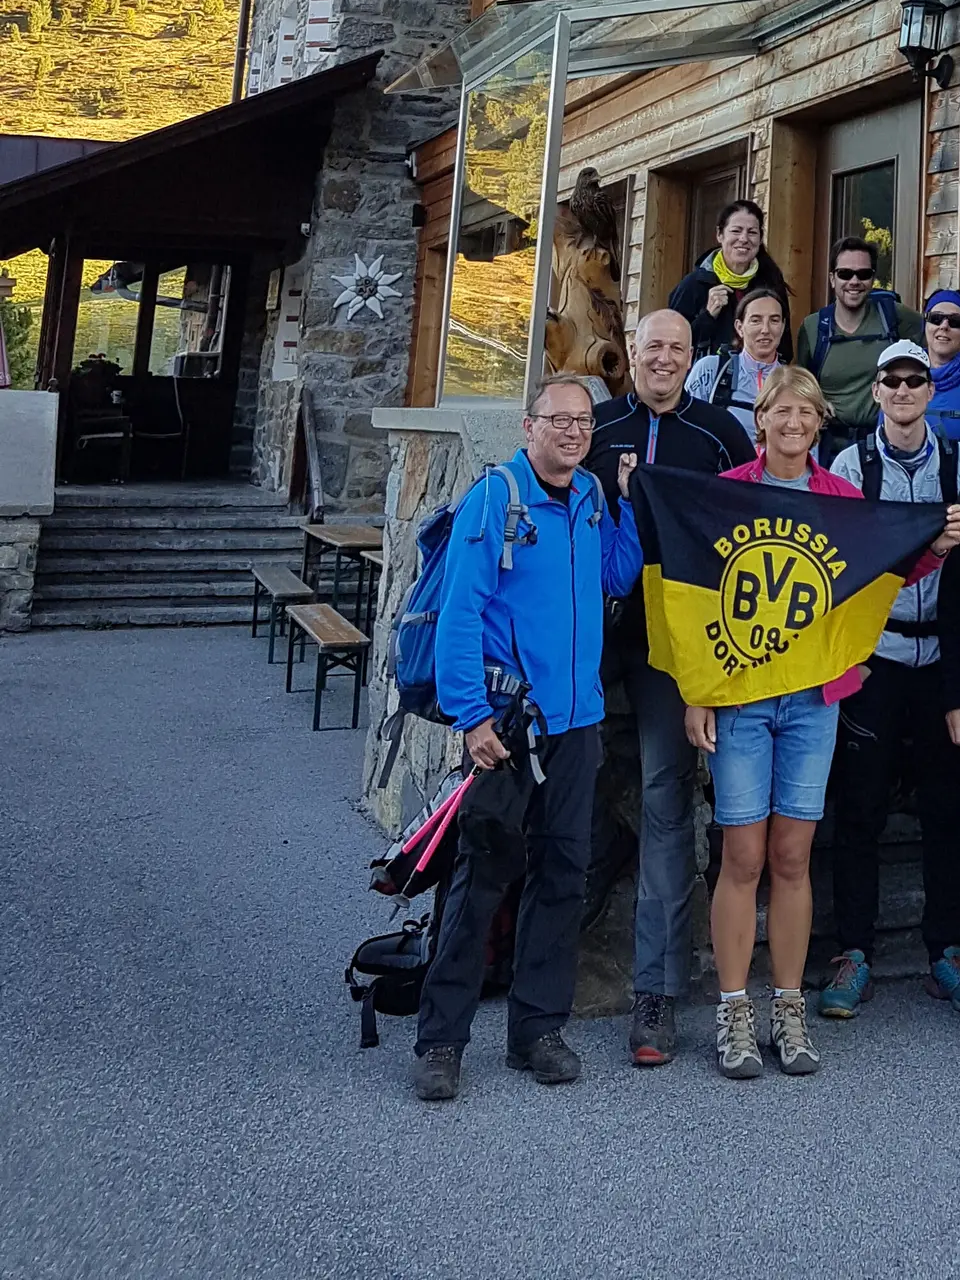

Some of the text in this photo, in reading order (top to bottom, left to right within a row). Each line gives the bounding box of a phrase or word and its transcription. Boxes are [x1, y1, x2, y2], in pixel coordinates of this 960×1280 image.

[713, 517, 847, 580] BORUSSIA
[732, 550, 818, 630] BVB
[749, 624, 781, 651] 09
